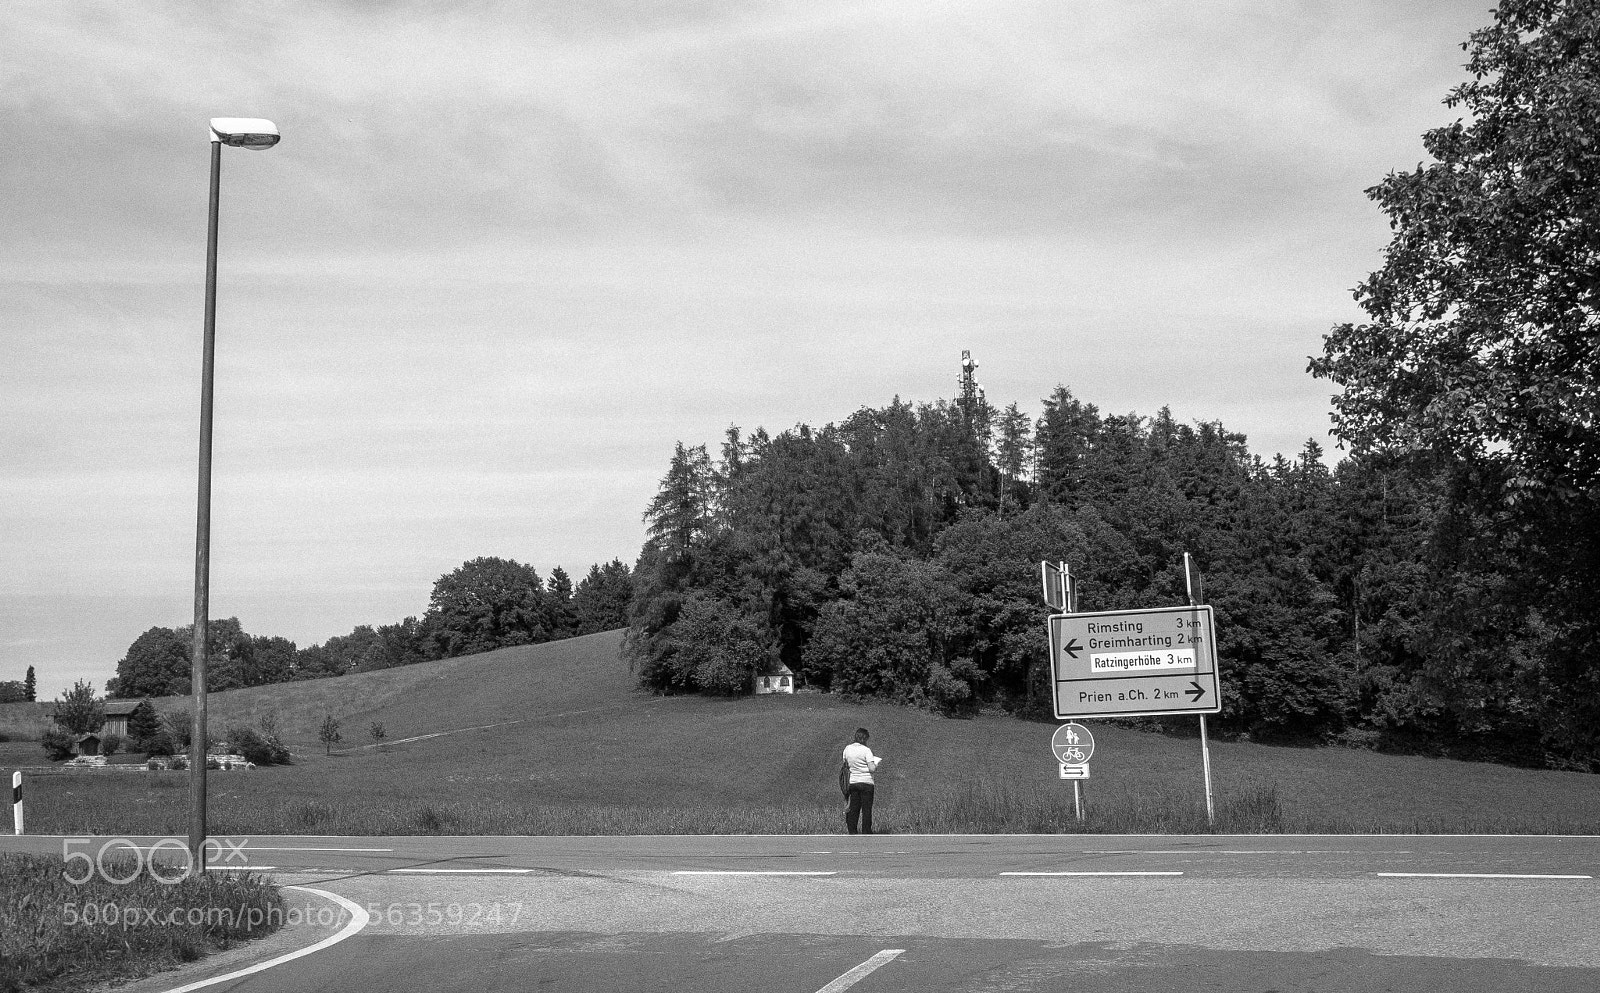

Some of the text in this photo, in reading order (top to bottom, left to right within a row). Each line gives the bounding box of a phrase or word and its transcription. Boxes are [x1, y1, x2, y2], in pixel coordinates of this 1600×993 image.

[1087, 618, 1202, 634] Rimsting 3 km
[1089, 633, 1203, 649] Greimharting 2 km
[1094, 654, 1193, 669] Ratzingerhöhe 3 km
[1079, 688, 1179, 703] Prien a.Ch. 2 km
